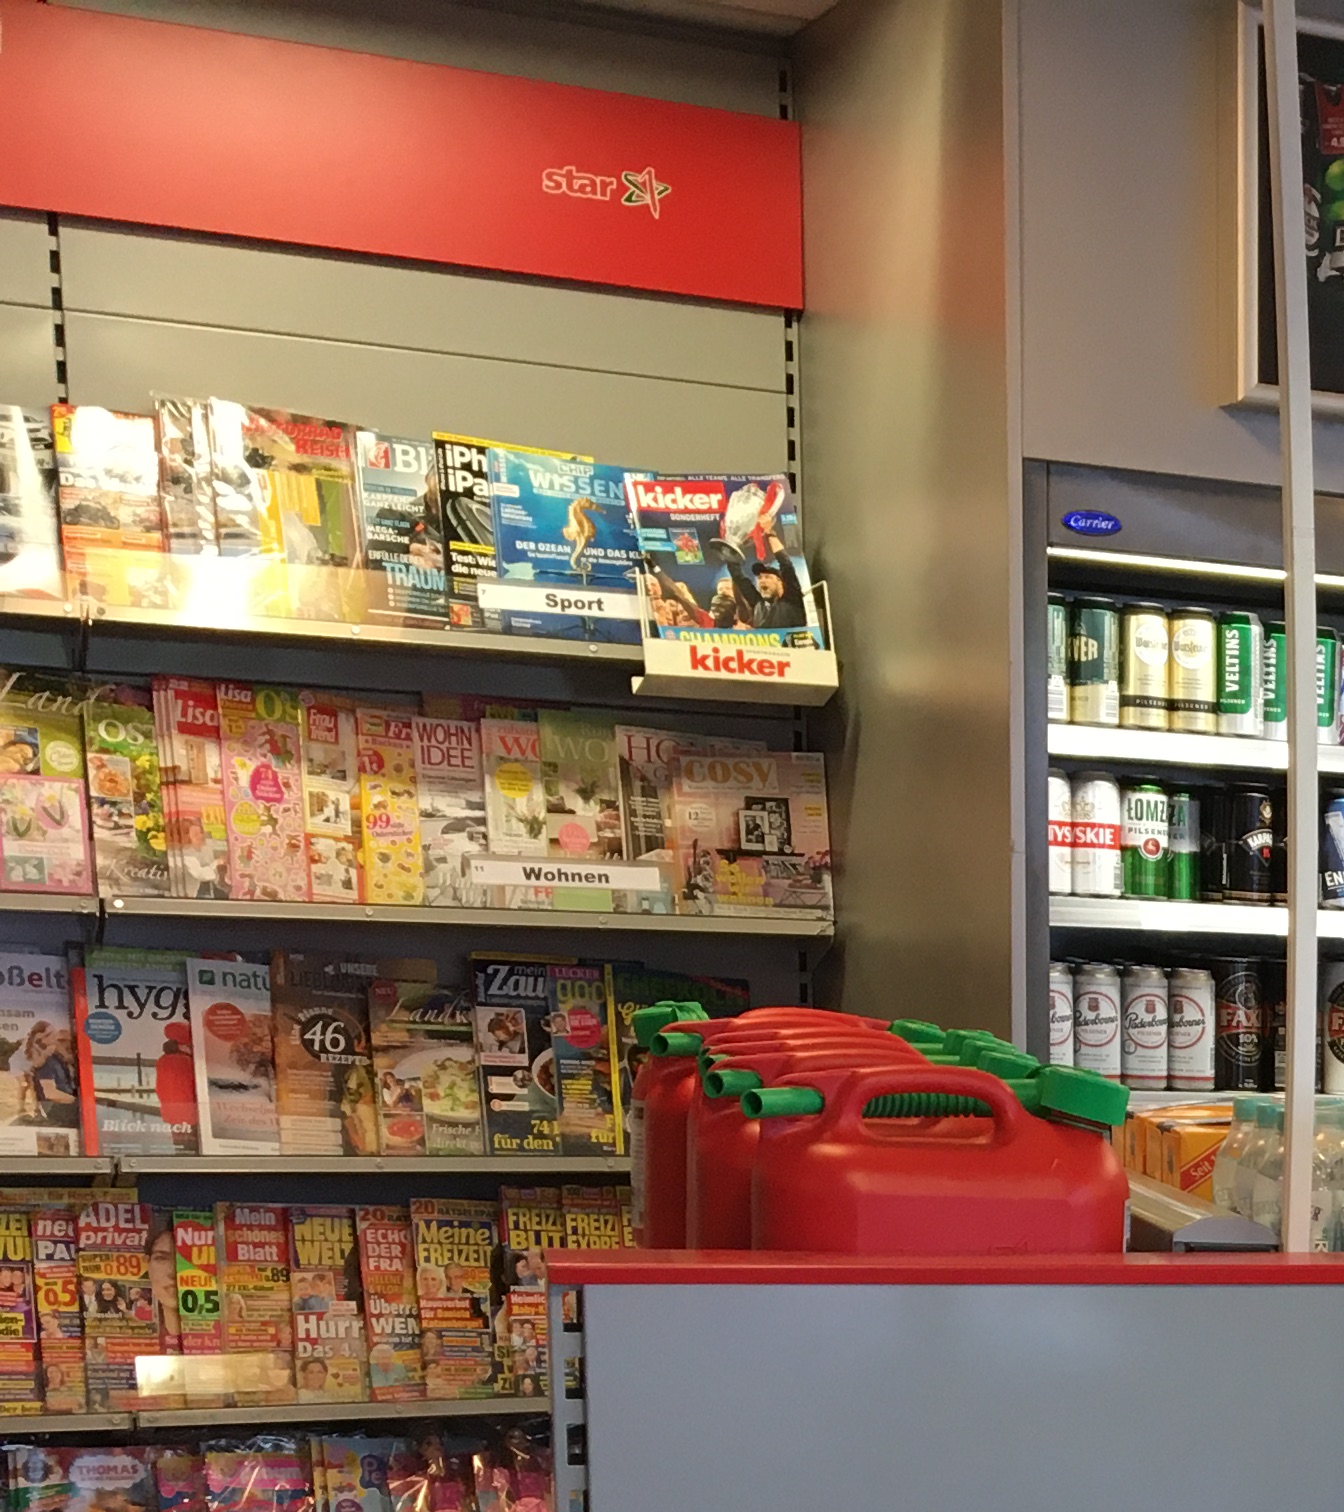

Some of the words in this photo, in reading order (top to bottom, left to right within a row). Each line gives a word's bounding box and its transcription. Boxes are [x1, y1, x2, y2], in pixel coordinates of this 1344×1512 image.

[542, 166, 616, 201] star
[529, 470, 625, 498] WISSEN
[636, 484, 723, 509] kicker
[1070, 514, 1116, 532] Carrier
[545, 593, 604, 612] Sport
[690, 646, 791, 677] kicker
[1225, 629, 1240, 693] VELTINS
[416, 722, 473, 747] WOHN
[421, 743, 475, 769] IDEE
[522, 866, 610, 884] Wohnen
[304, 1023, 346, 1053] 46
[102, 1119, 148, 1133] Blick
[79, 1203, 148, 1229] ADEL
[418, 1221, 490, 1244] Meine
[237, 1244, 279, 1262] Blatt
